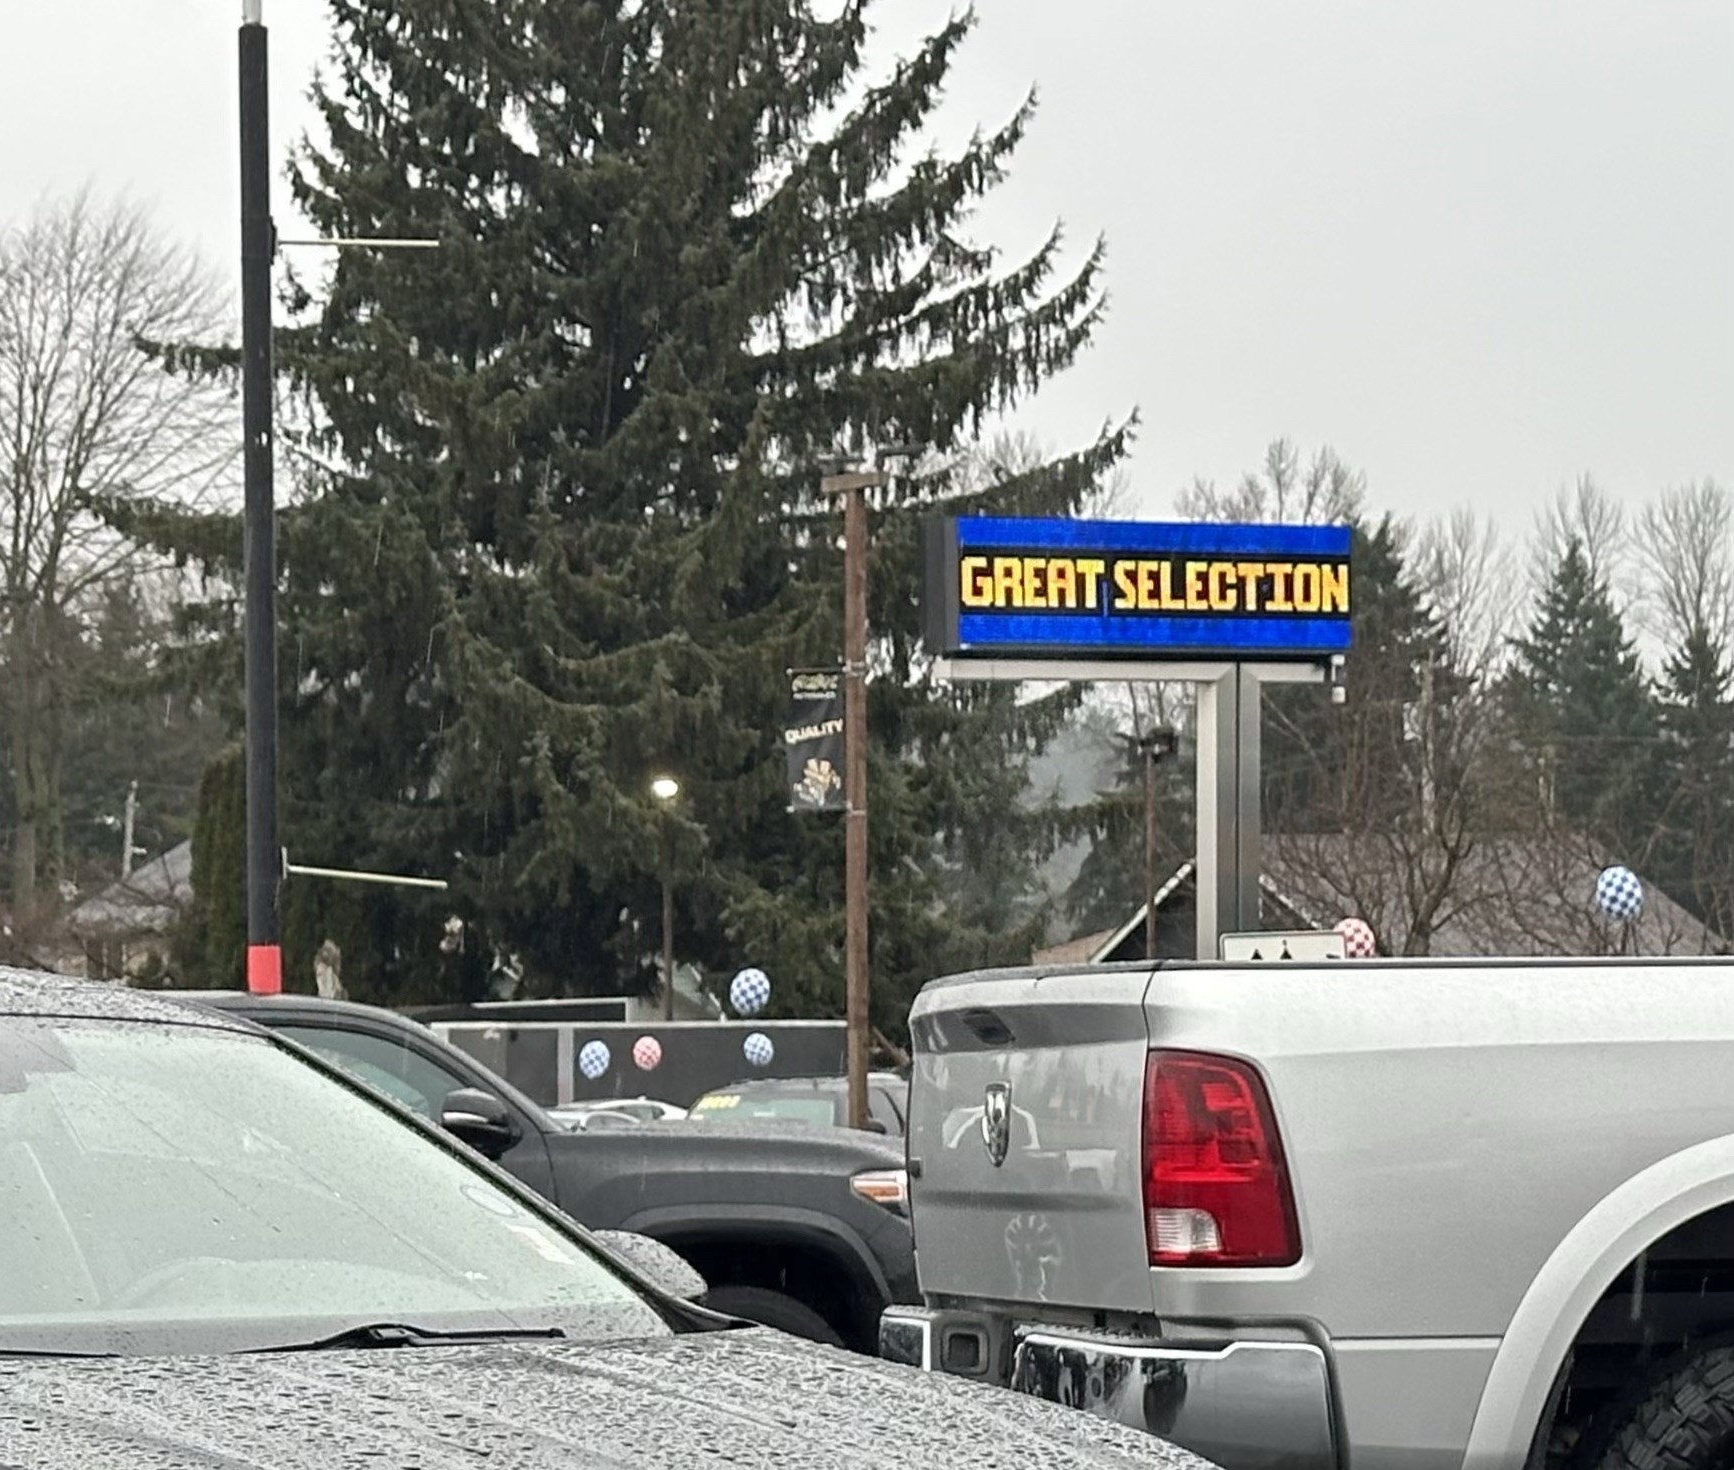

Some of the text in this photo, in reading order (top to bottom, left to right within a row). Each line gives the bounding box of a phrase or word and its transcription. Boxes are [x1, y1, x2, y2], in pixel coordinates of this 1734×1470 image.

[961, 556, 1349, 612] GREAT SELECTION
[785, 718, 843, 744] QUALITY
